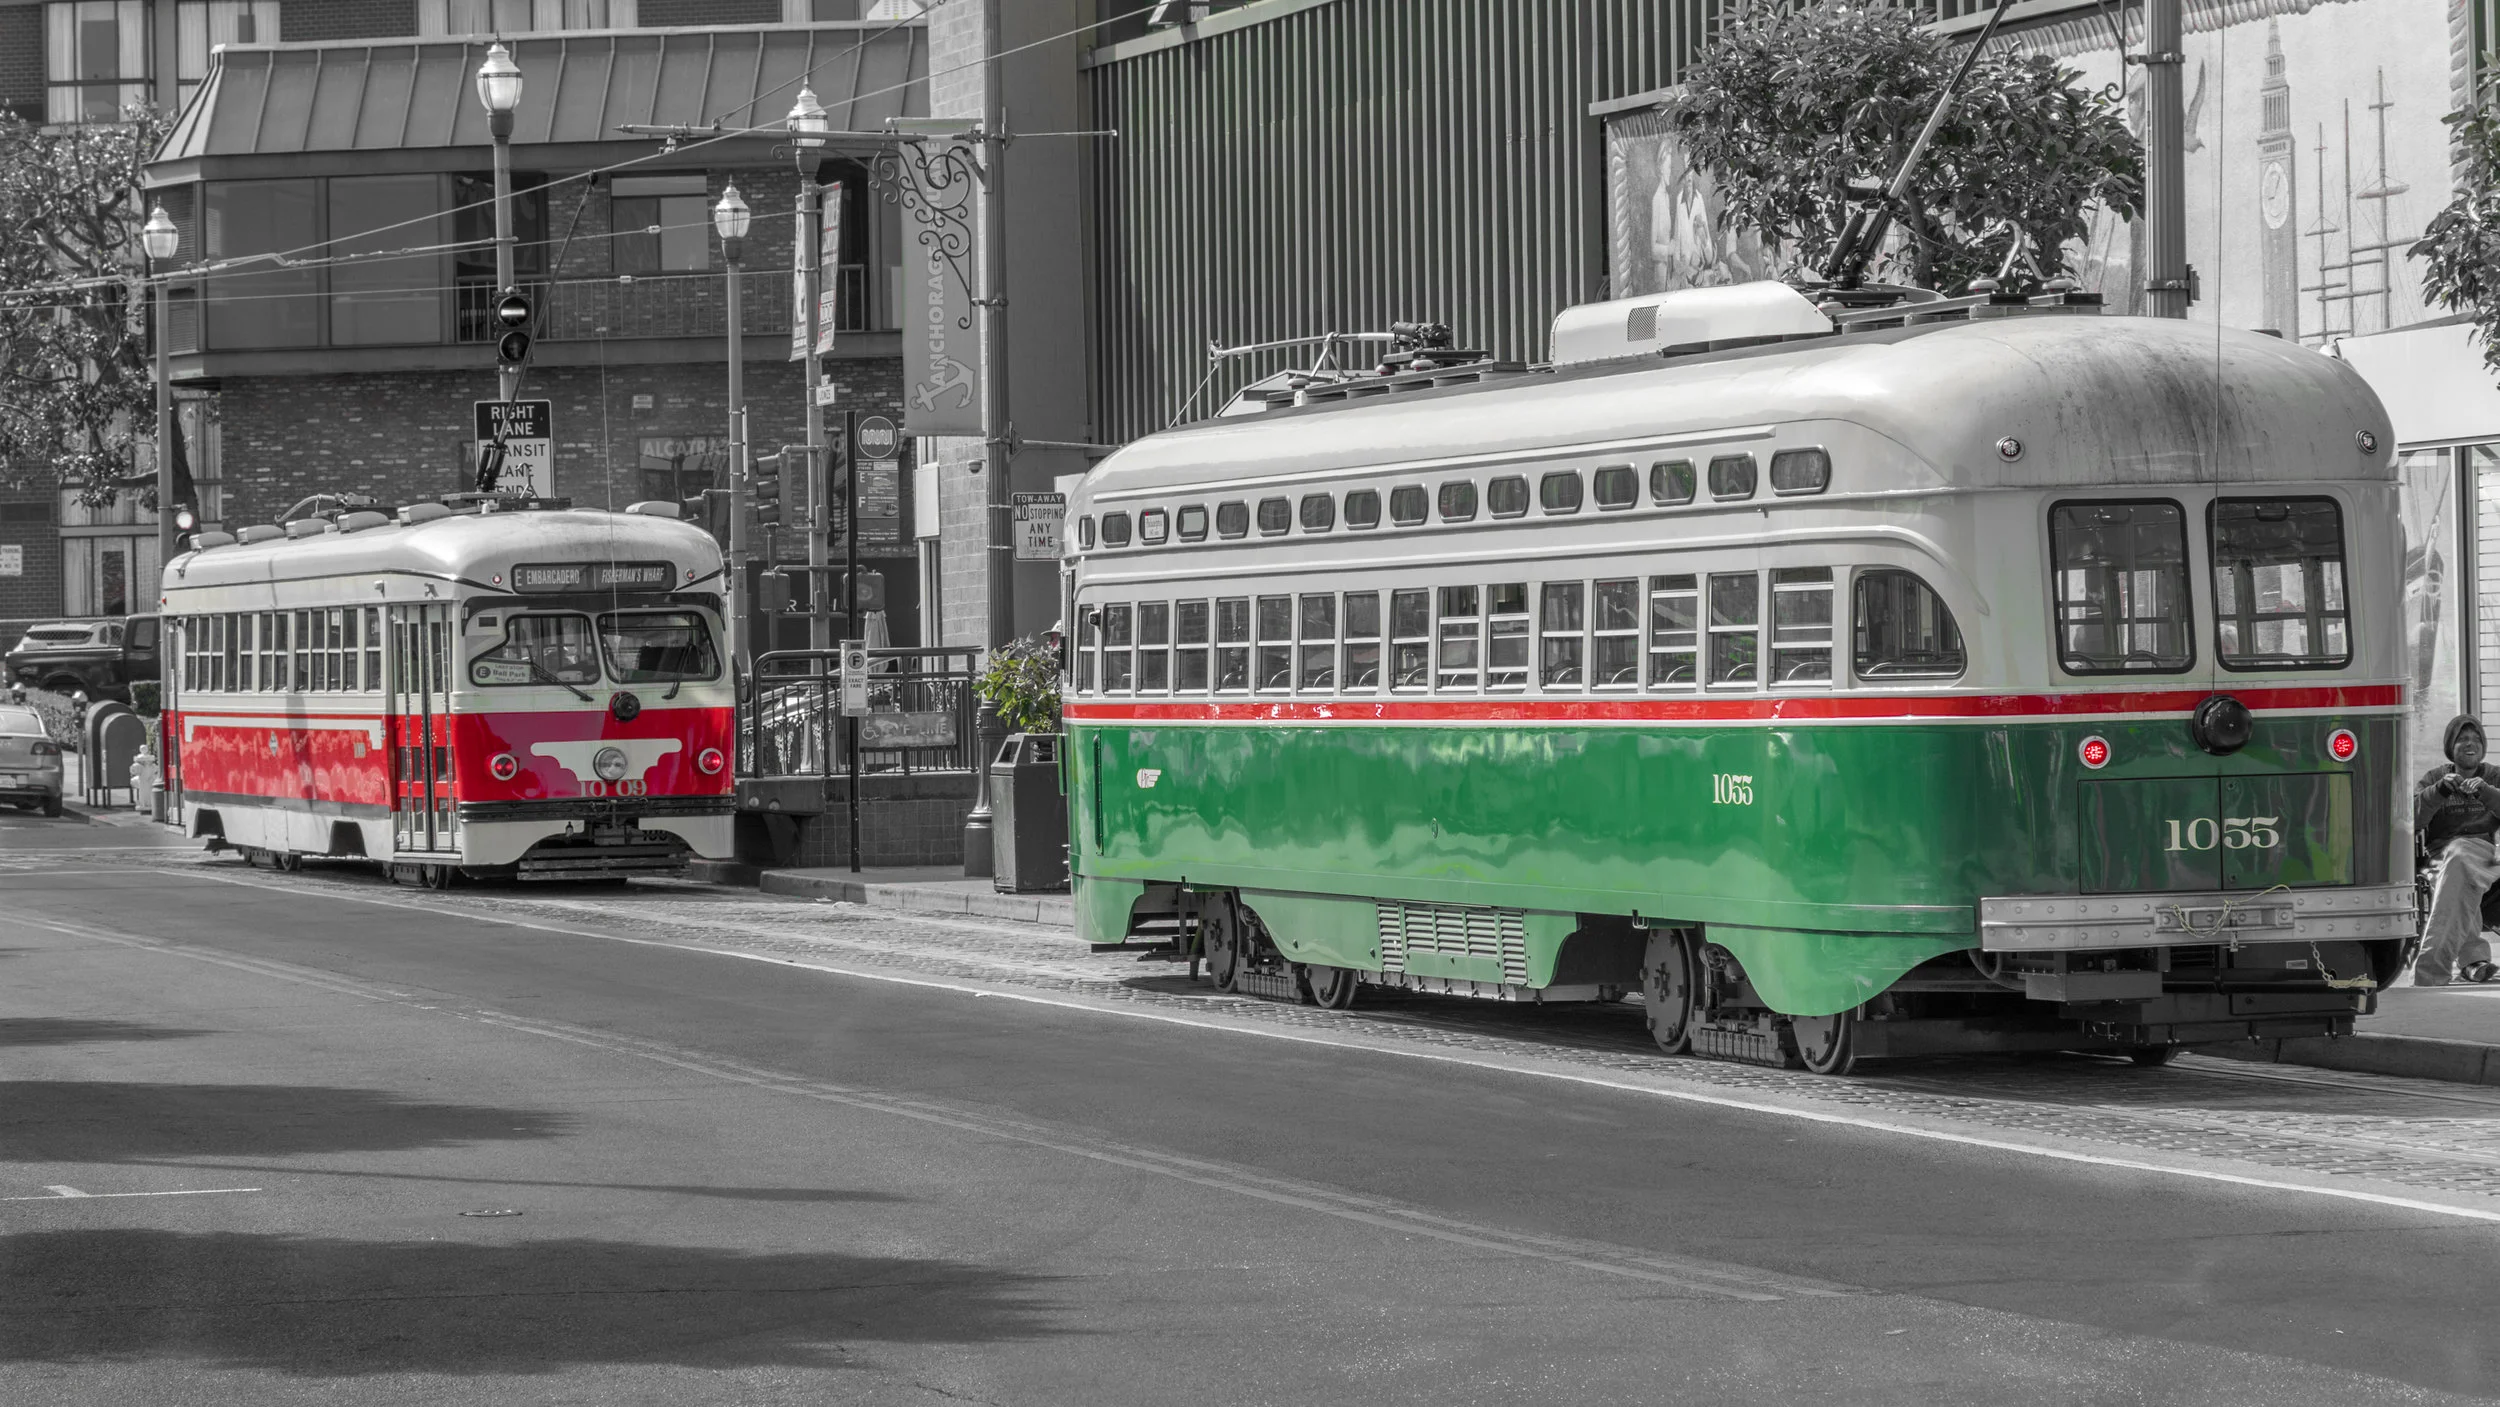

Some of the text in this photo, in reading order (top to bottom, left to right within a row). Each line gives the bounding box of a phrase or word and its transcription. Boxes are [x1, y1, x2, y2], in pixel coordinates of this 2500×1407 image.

[927, 246, 946, 387] ANCHORAGE
[491, 405, 535, 419] RIGHT
[493, 422, 534, 435] LANE
[483, 444, 546, 457] ANSIT
[500, 464, 534, 478] ANE
[858, 496, 866, 508] F
[1016, 495, 1062, 504] TOW-AWAY
[1015, 505, 1064, 520] NO STOPPING
[1029, 523, 1051, 534] ANY
[1028, 536, 1054, 548] TIME
[515, 568, 665, 586] E EMBARCADERO FISHERMAN'S WHARF
[853, 656, 860, 667] F
[1712, 773, 1753, 806] 1055
[2164, 816, 2280, 851] 1055
